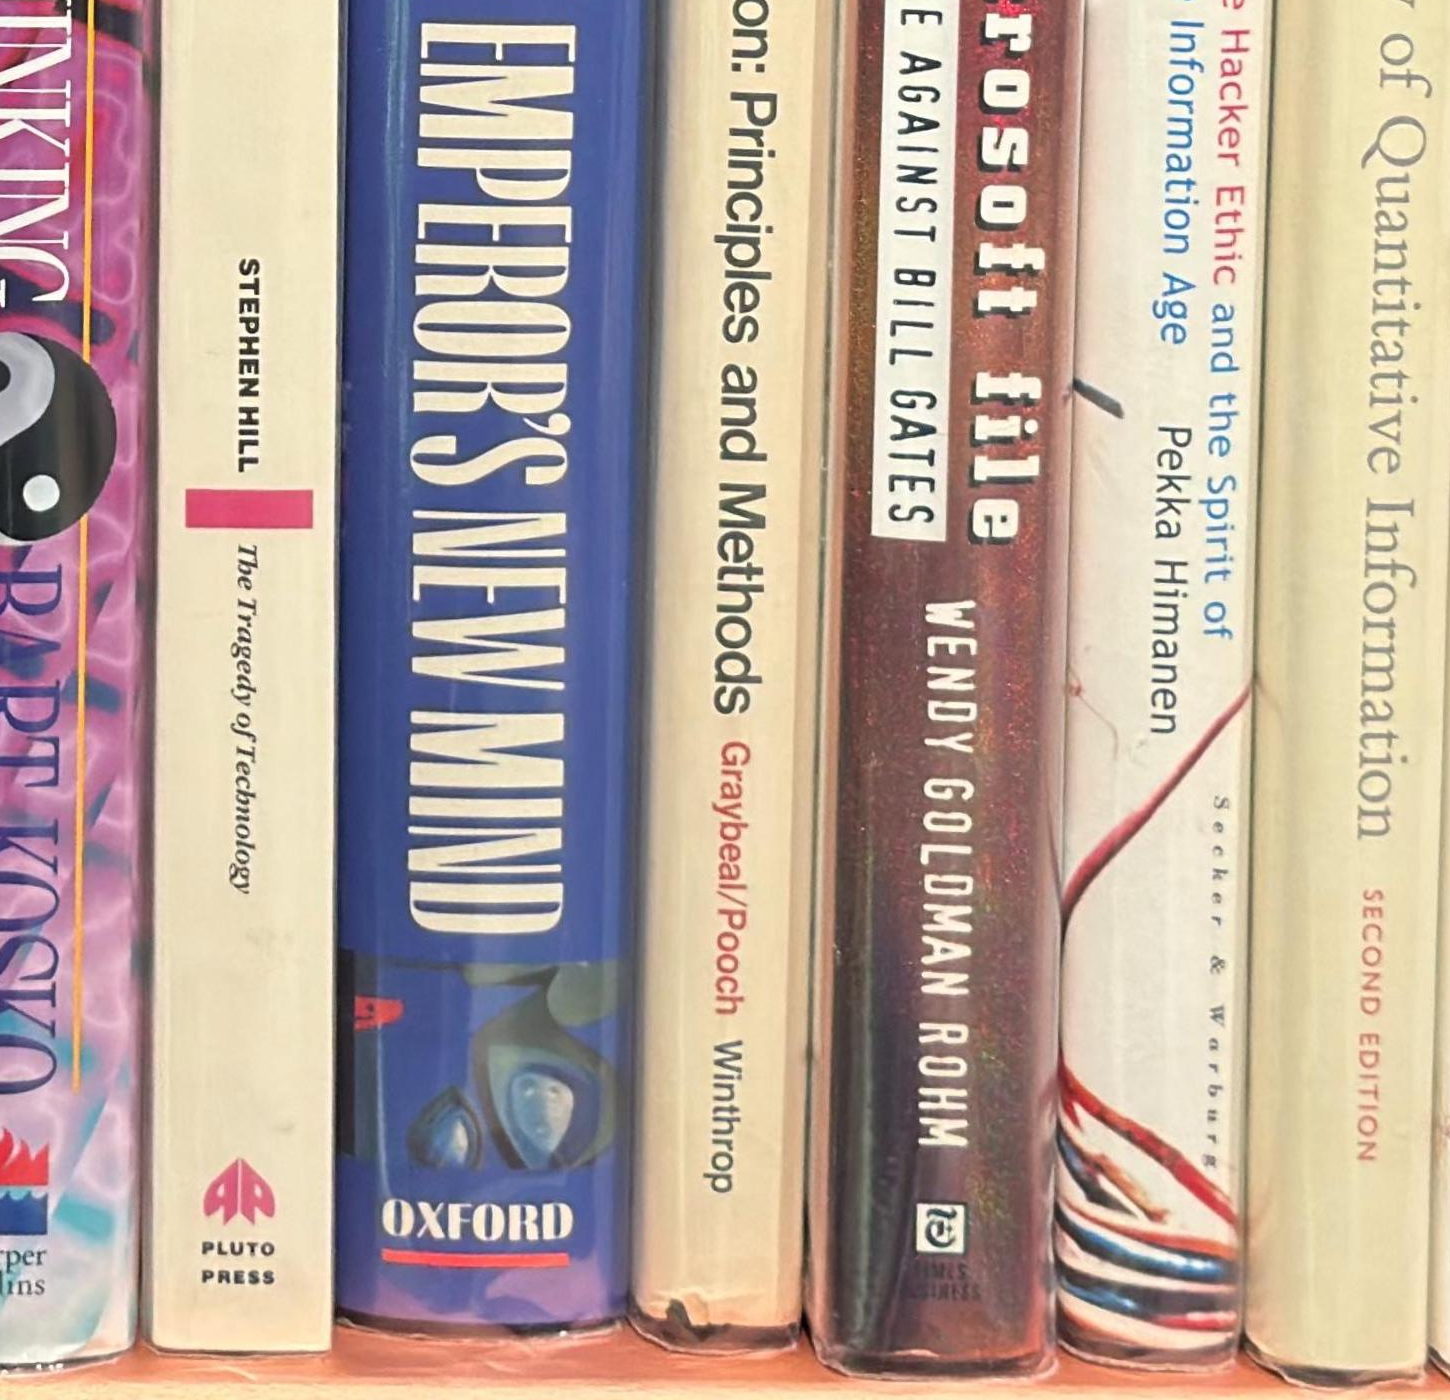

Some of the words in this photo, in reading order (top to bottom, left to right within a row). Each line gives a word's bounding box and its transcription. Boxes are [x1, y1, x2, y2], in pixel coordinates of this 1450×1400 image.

[1218, 30, 1250, 166] Hacker
[1380, 34, 1432, 98] of
[1164, 21, 1204, 253] Information
[410, 23, 576, 485] EMPEROR'S
[713, 92, 777, 343] Principles
[1213, 186, 1244, 285] Ethic
[239, 259, 260, 397] STEPHEN
[1152, 272, 1196, 344] Age
[1211, 304, 1239, 372] and
[1362, 116, 1426, 474] Quantitative
[239, 407, 259, 472] HILL
[720, 364, 767, 461] and
[969, 370, 1042, 546] file
[1209, 393, 1238, 457] the
[1156, 427, 1192, 539] Pekka
[1200, 475, 1236, 583] Spirit
[238, 545, 258, 590] The
[412, 511, 566, 690] NEW
[714, 483, 766, 714] Methods
[1204, 602, 1233, 639] of
[231, 599, 256, 706] Tragedy
[1151, 560, 1188, 733] Himanen
[1357, 498, 1417, 840] Information
[230, 713, 256, 743] of
[229, 747, 256, 894] Technology
[408, 711, 564, 934] MIND
[712, 742, 751, 1014] Graybeal/Pooch
[1360, 890, 1384, 1016] SECOND
[703, 1040, 743, 1193] Winthrop
[1357, 1033, 1380, 1161] EDITION
[201, 1242, 275, 1257] PLUTO
[201, 1269, 275, 1285] PRESS
[382, 1199, 573, 1241] OXFORD
